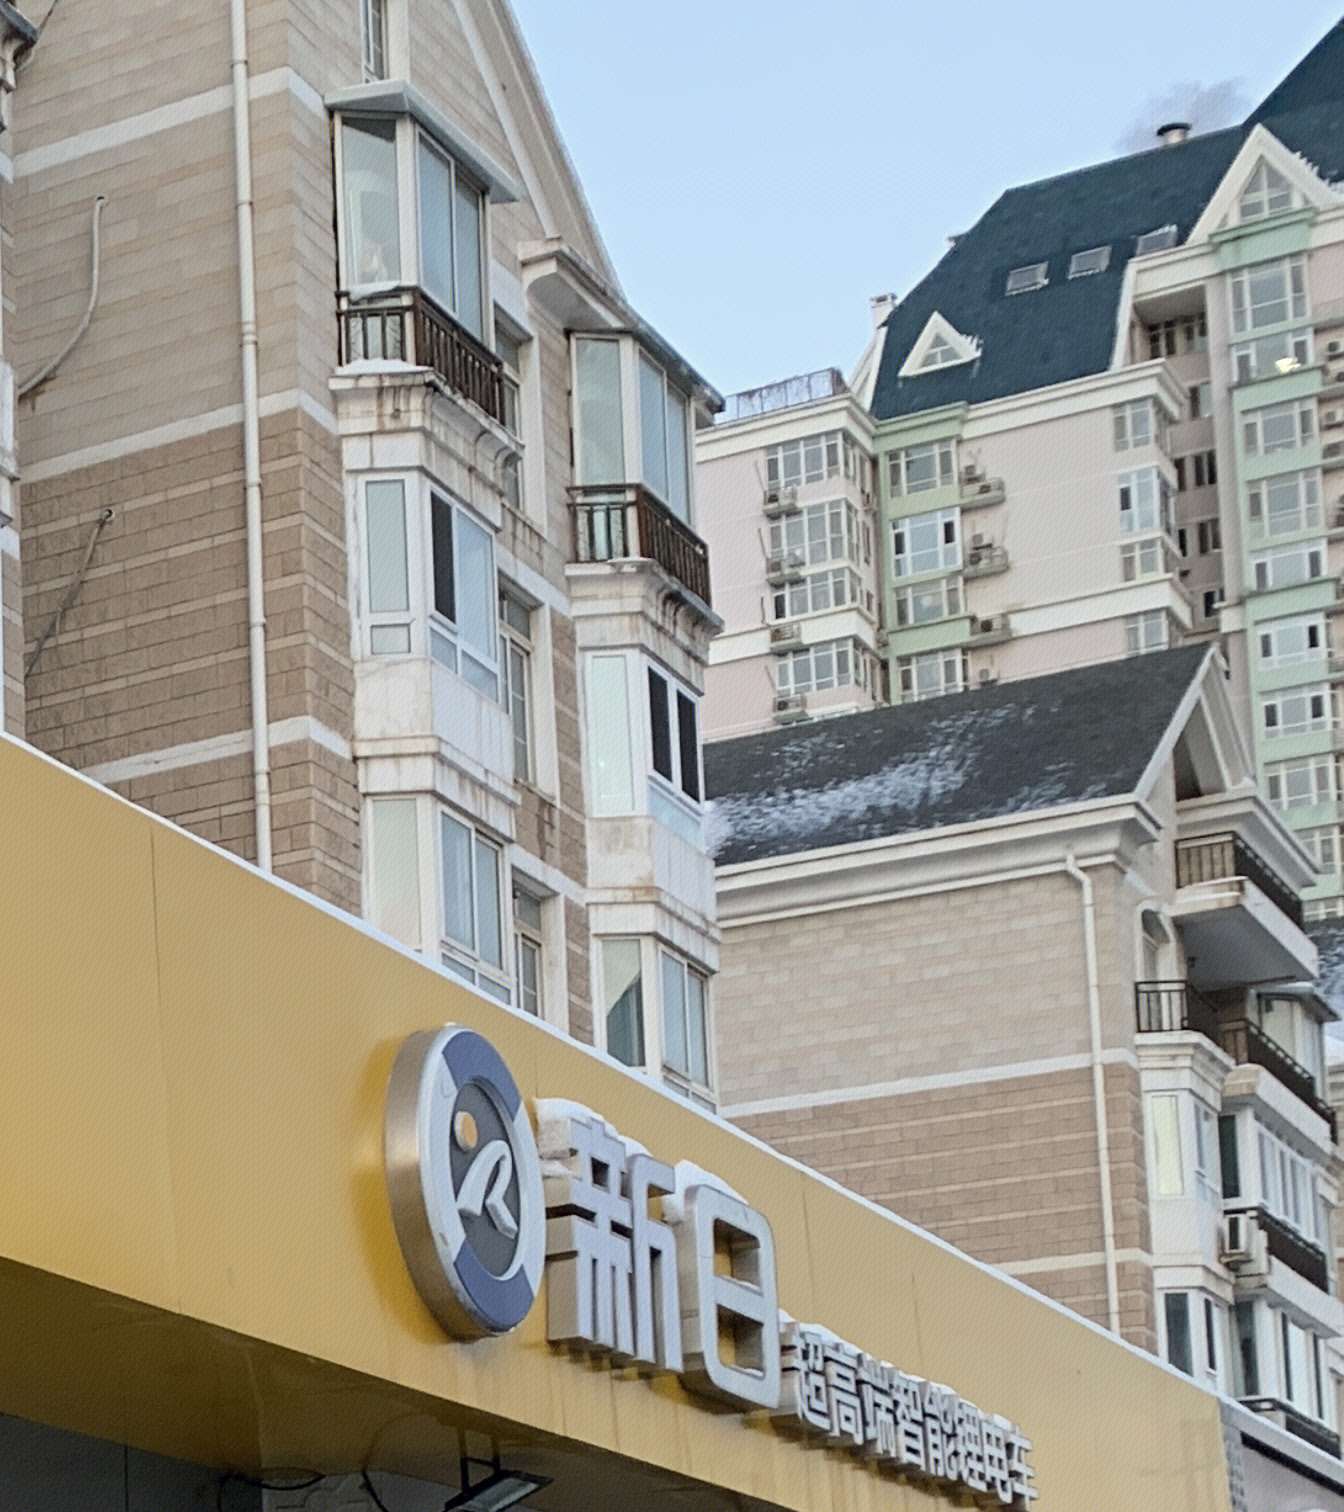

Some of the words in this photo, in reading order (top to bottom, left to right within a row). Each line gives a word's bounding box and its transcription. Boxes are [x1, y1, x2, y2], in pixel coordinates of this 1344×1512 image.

[548, 1113, 781, 1411] 新日
[794, 1327, 1039, 1512] 超高端智能锂电车
